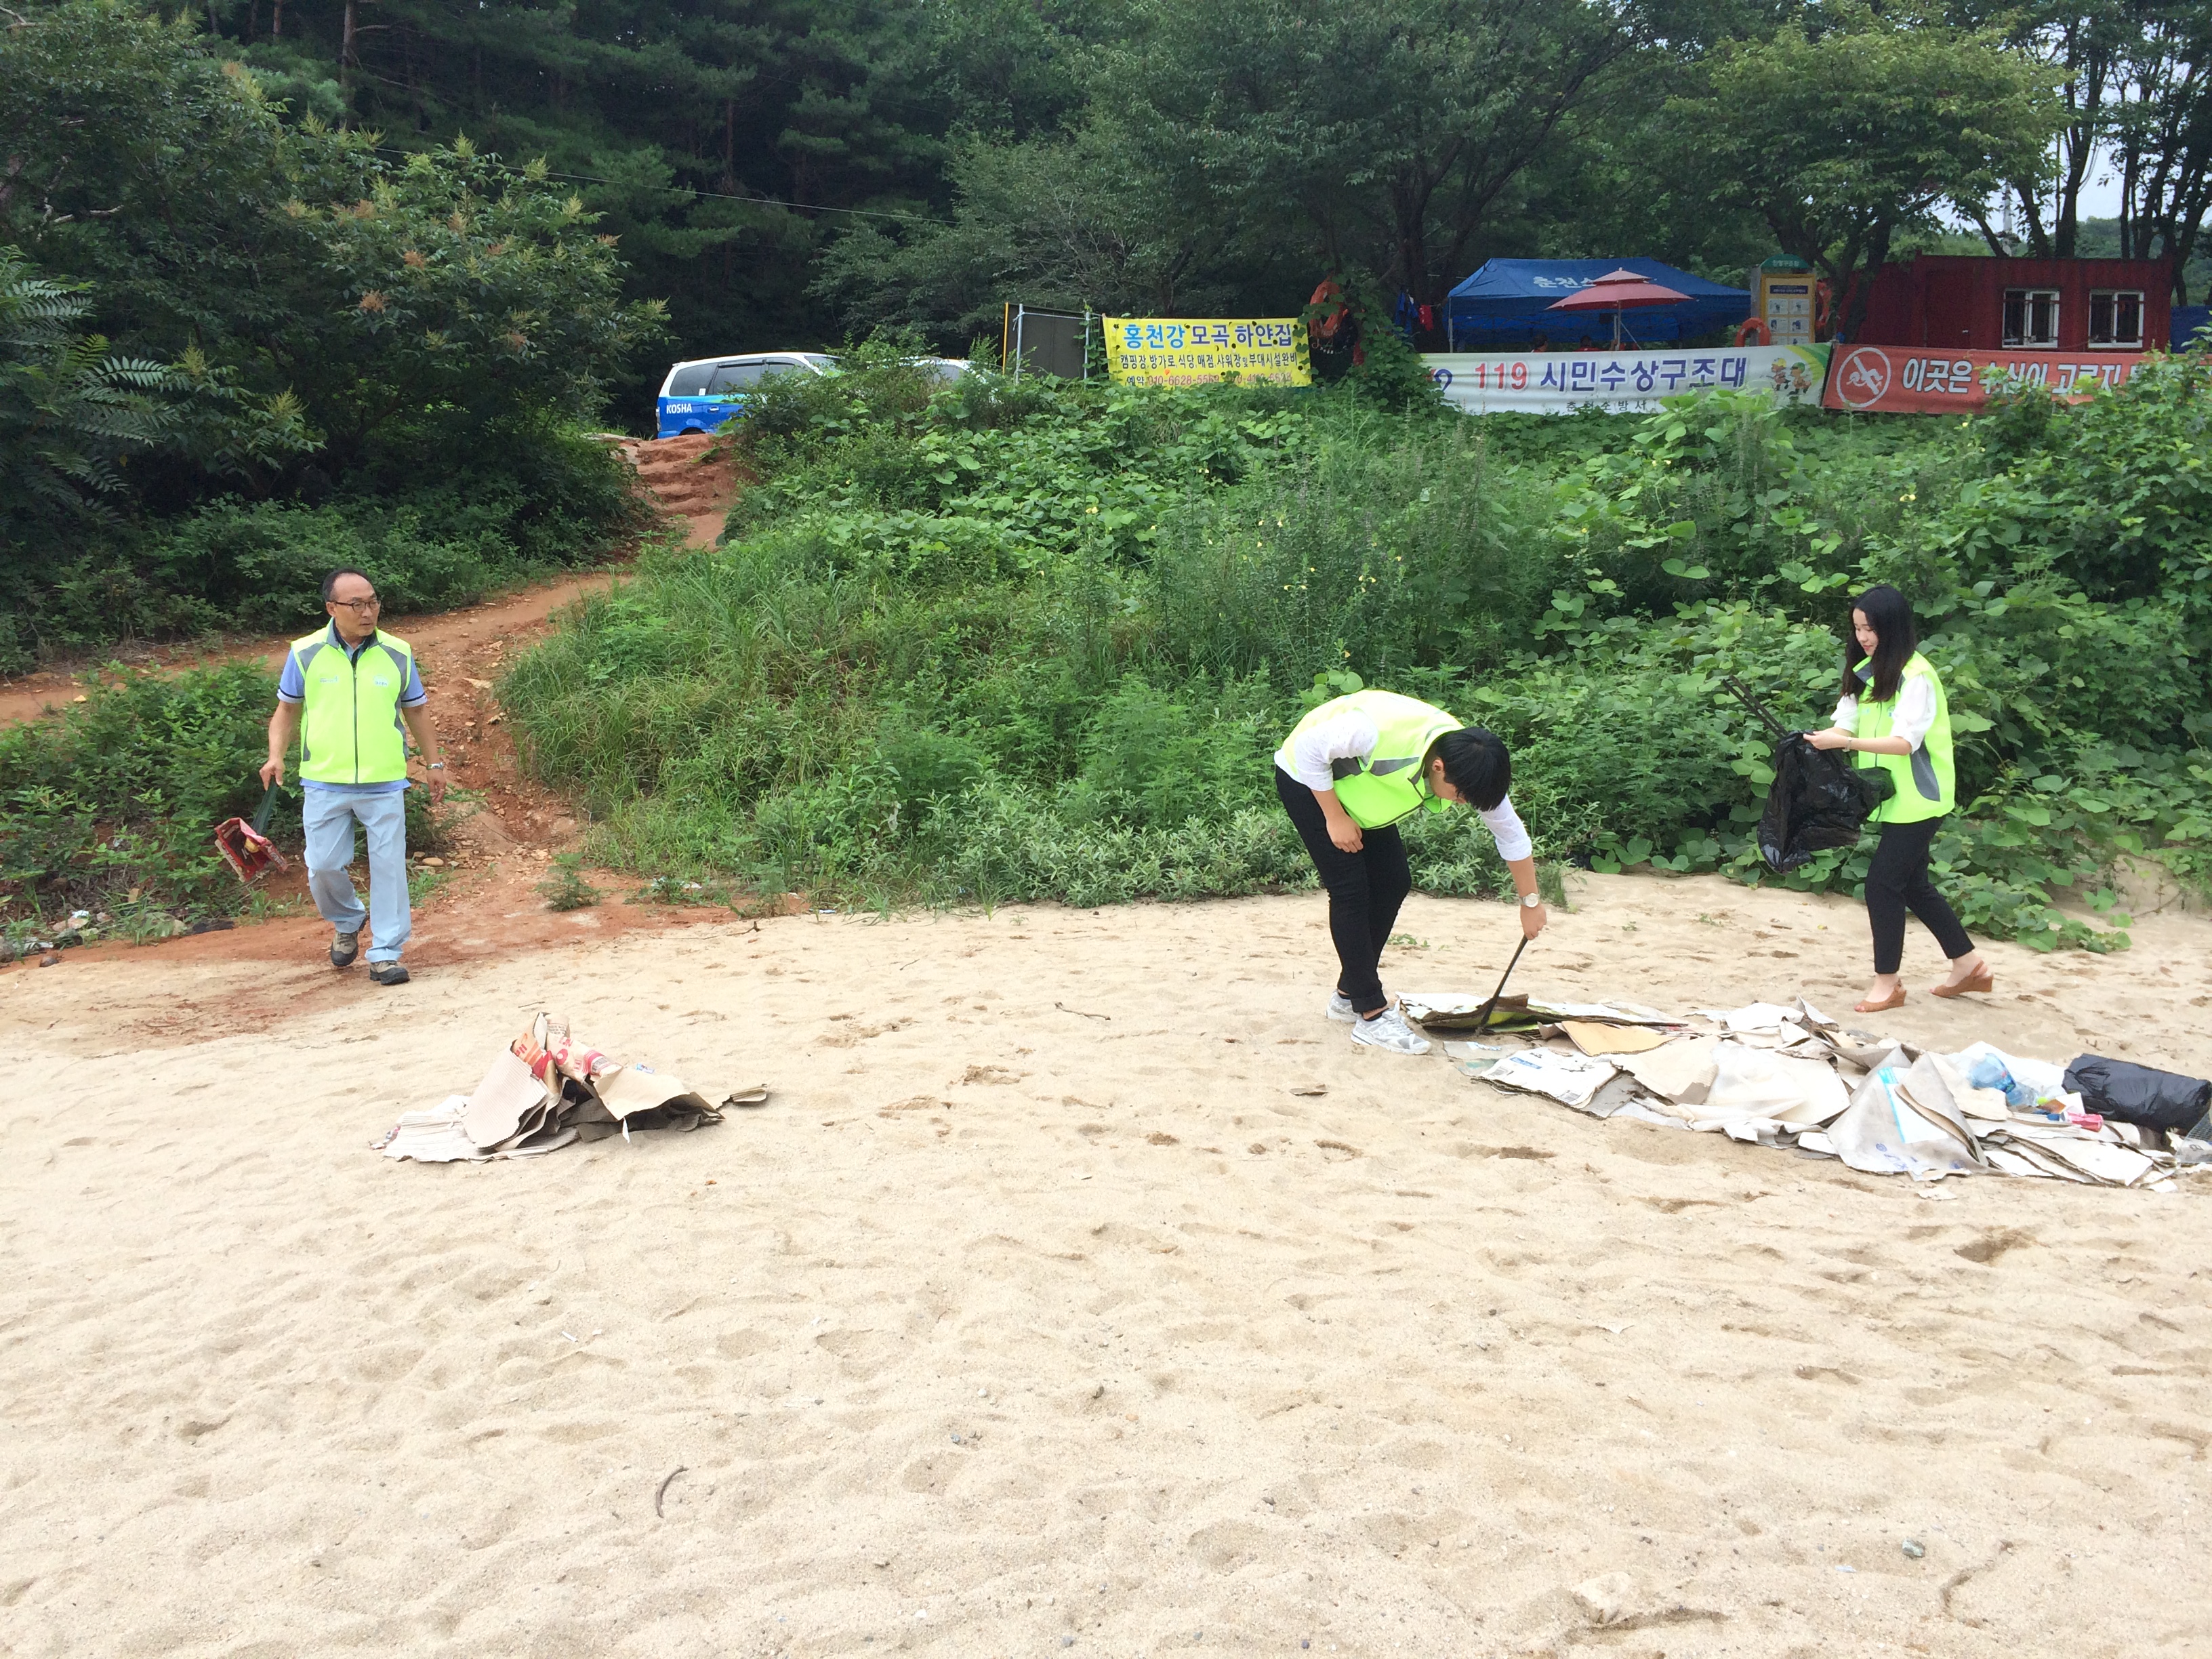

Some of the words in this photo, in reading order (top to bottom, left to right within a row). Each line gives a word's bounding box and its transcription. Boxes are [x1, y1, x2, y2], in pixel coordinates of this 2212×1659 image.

[1123, 324, 1185, 349] 홍천강
[1191, 324, 1230, 347] 모곡
[1235, 323, 1292, 348] 하얀집
[1126, 375, 1145, 386] 예약
[1474, 361, 1529, 390] 119
[1540, 356, 1747, 392] 시민수상구조대
[1902, 357, 1973, 394] 이곳은
[666, 403, 692, 414] KOSHA
